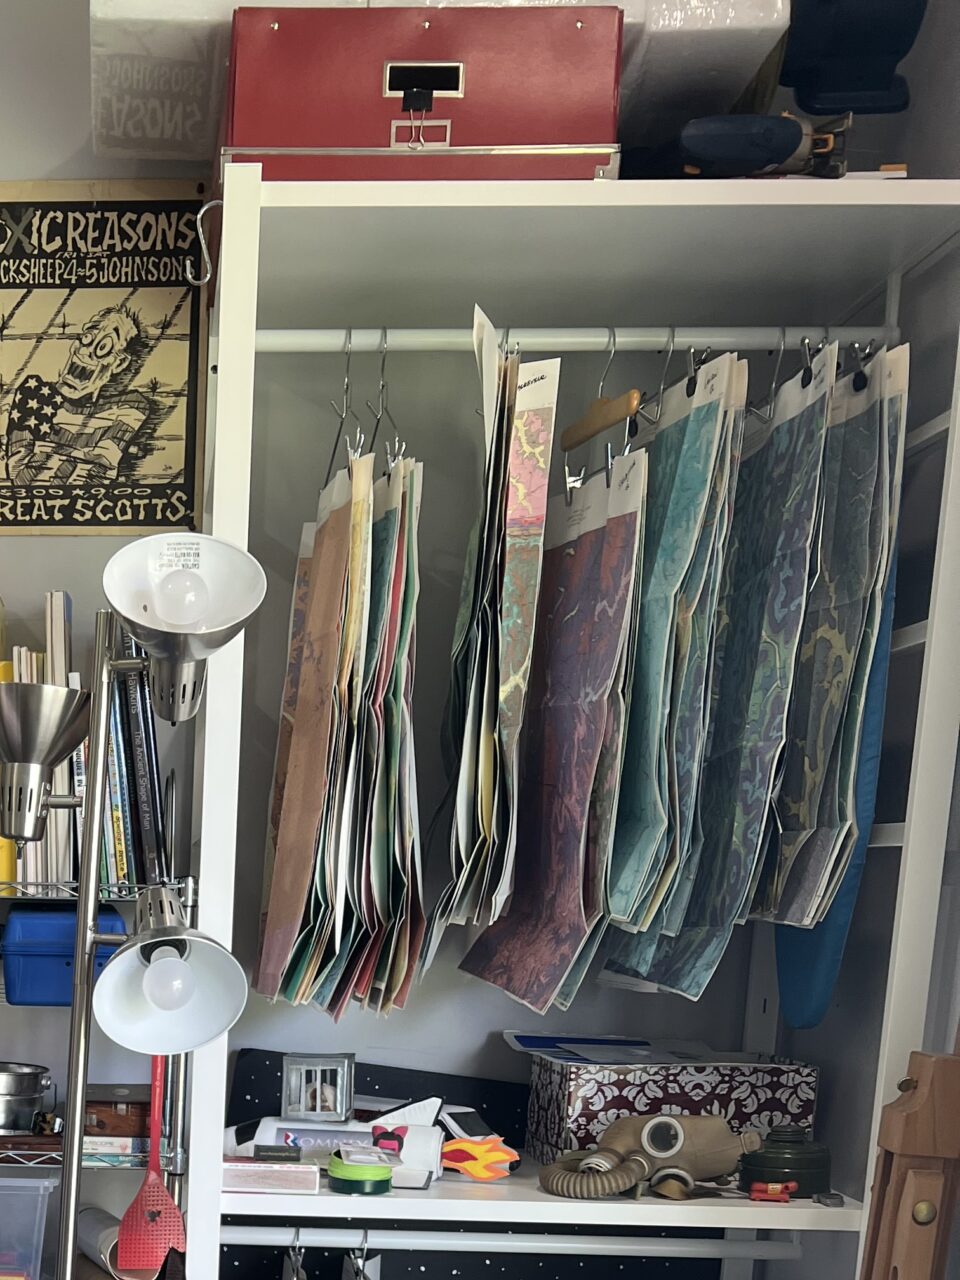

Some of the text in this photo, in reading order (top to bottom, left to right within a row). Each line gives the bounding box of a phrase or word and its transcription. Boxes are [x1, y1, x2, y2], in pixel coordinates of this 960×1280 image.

[66, 208, 197, 253] REASONS
[128, 672, 137, 715] Hawkins
[135, 748, 145, 776] Ancient
[139, 777, 148, 804] Shape
